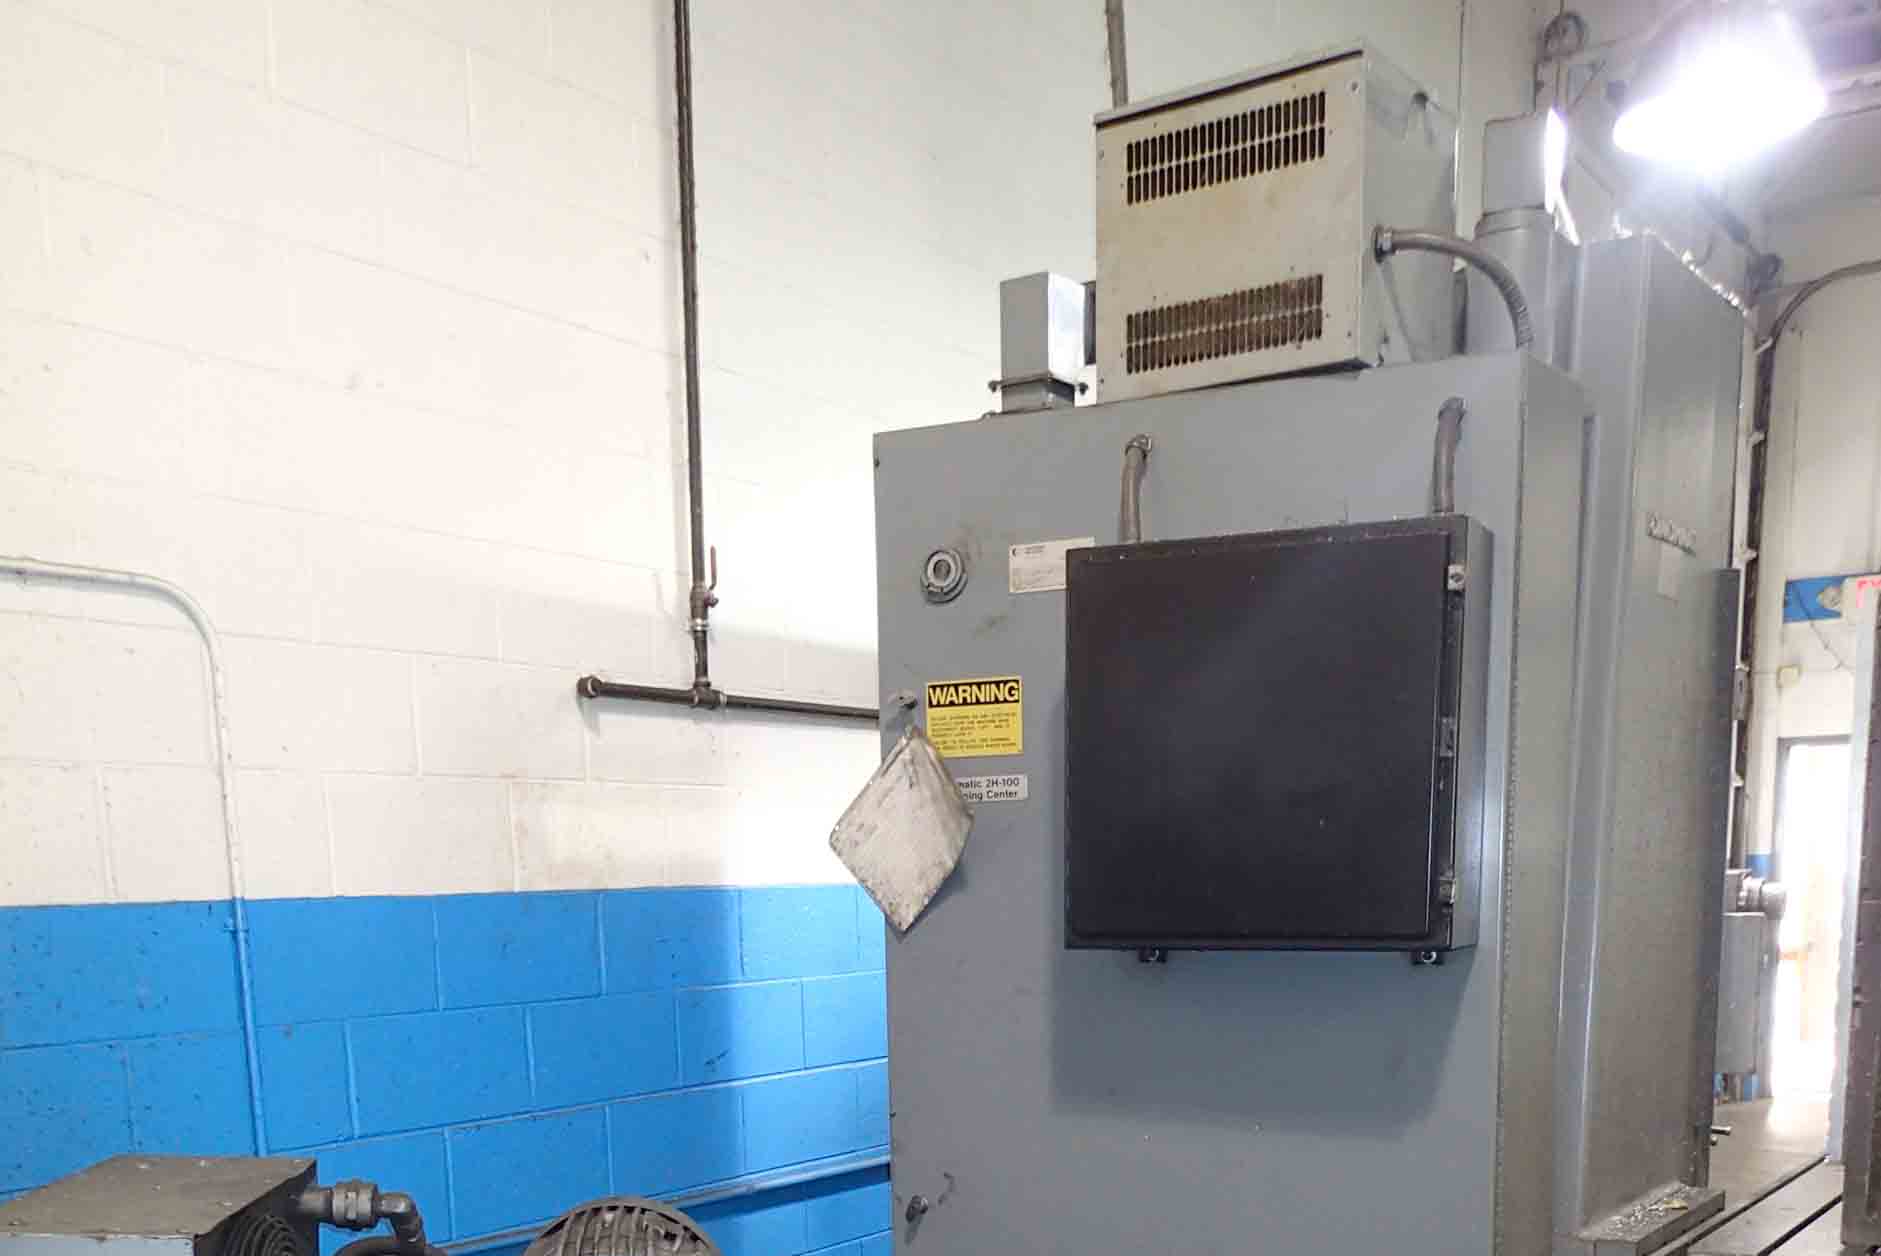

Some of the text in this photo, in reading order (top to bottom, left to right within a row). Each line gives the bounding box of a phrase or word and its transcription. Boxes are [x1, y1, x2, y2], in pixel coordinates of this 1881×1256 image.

[929, 681, 1019, 705] WARNING
[986, 777, 1020, 788] 2H-100
[987, 789, 1018, 799] Center
